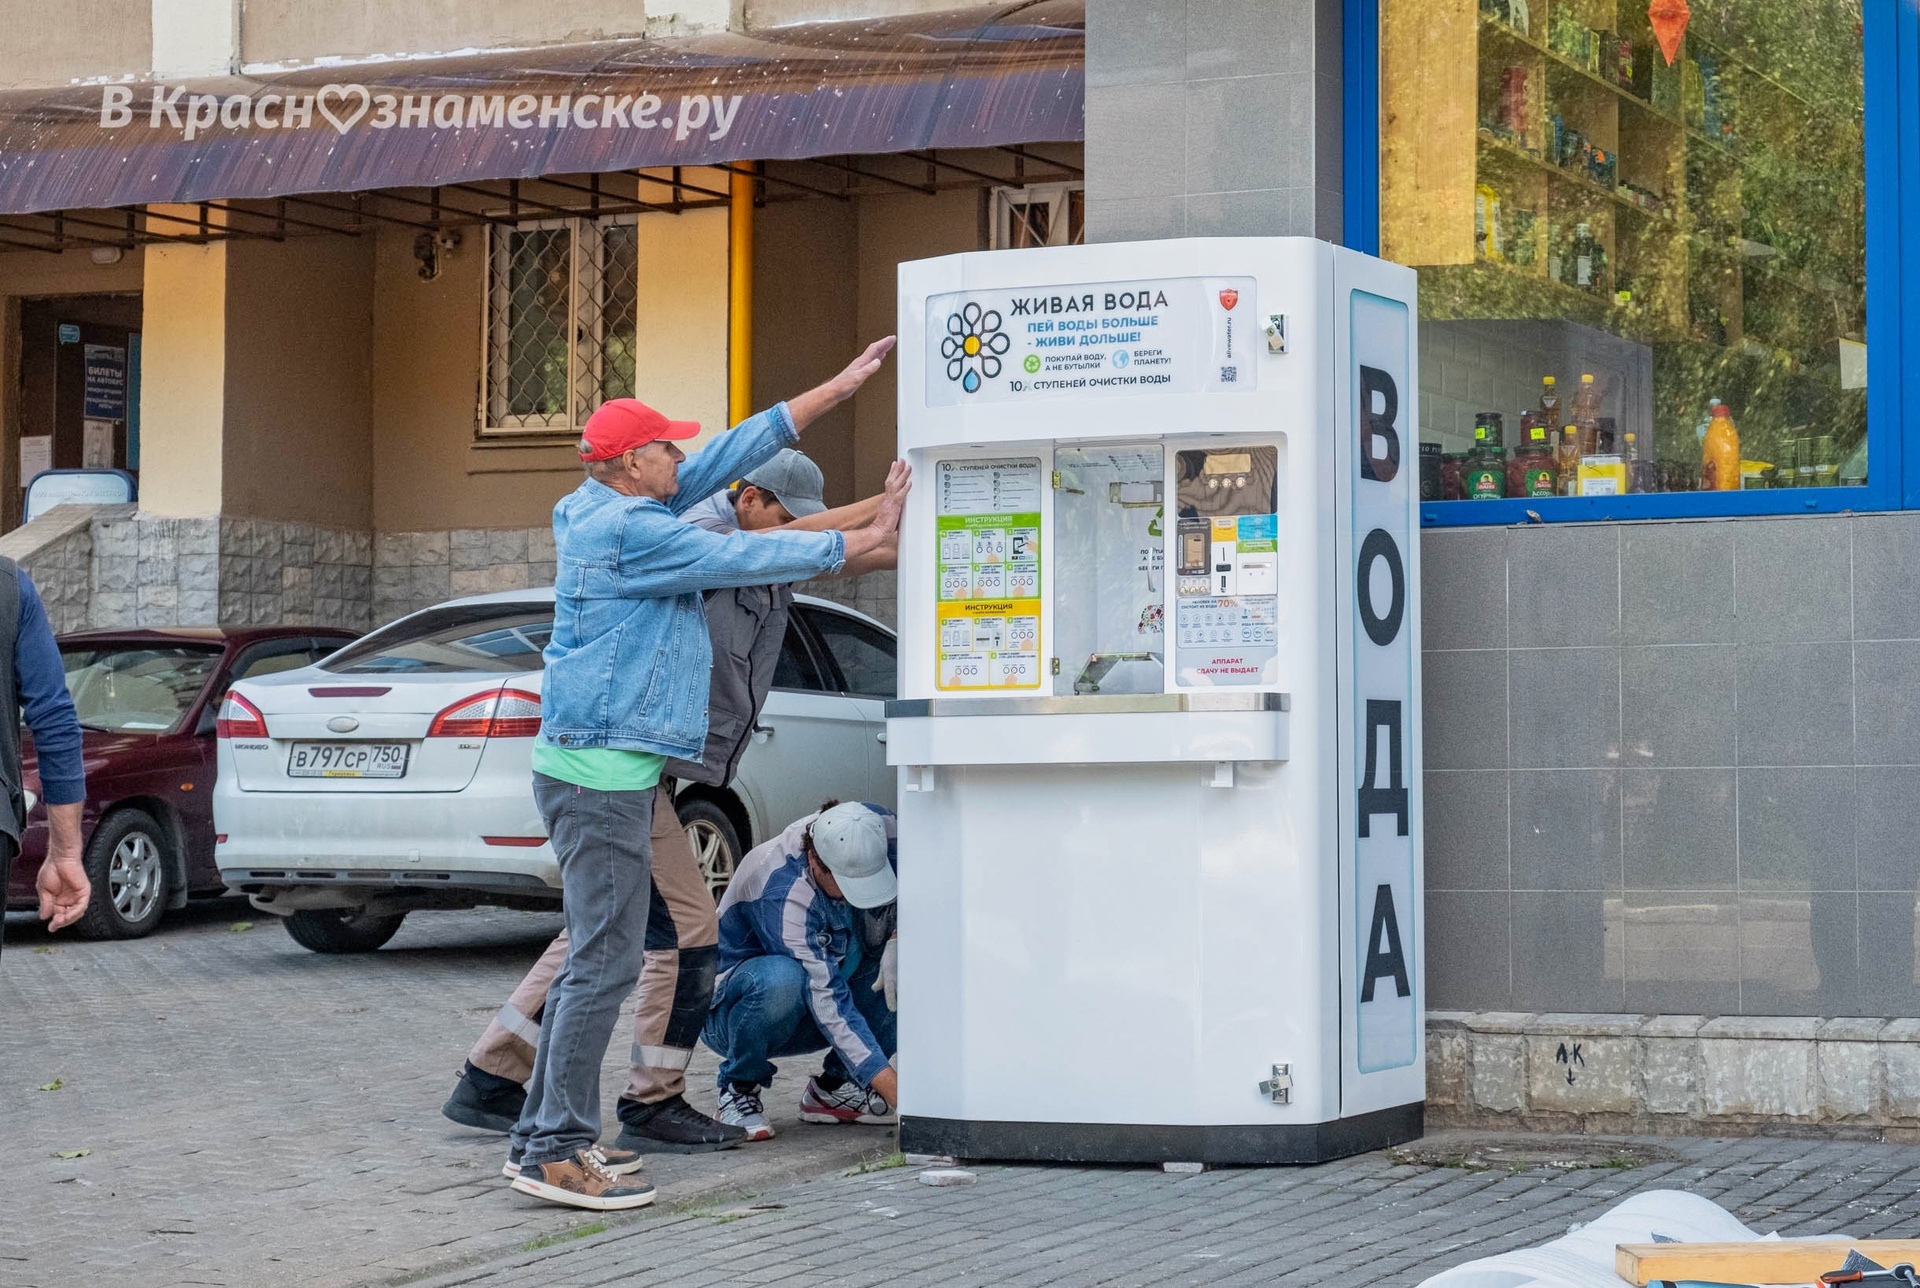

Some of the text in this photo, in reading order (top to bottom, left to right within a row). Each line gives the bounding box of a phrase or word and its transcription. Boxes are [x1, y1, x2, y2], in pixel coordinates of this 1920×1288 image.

[1010, 290, 1169, 316] ЖИВАЯ ВОДА
[1027, 315, 1159, 333] ПЕЙ ВОДЫ БОЛЬШЕ
[1035, 335, 1076, 348] ЖИВИ
[1079, 331, 1142, 347] ДОЛЬШЕ!
[1045, 352, 1107, 363] ПОКУПАЙ ВОДУ,
[1133, 349, 1163, 358] БЕРЕГИ
[1064, 362, 1101, 371] БУТЫЛКИ
[1133, 357, 1172, 366] ПЛАНЕТУ!
[88, 366, 123, 378] БИЛЕТЫ
[1033, 377, 1087, 390] СТУПЕНЕЙ
[1089, 375, 1138, 387] ОЧИСТКИ
[1139, 374, 1171, 385] ВОДЫ
[960, 463, 989, 472] СТУПЕНЕЙ
[964, 515, 1013, 524] ИНСТРУКЦИЯ
[964, 603, 1013, 611] ИНСТРУКЦИЯ
[1217, 598, 1238, 608] 70%
[1196, 667, 1219, 675] СДАЧУ
[1230, 666, 1259, 674] ВЫДАЕТ
[1357, 363, 1412, 1004] ВОДА
[373, 746, 401, 763] 750
